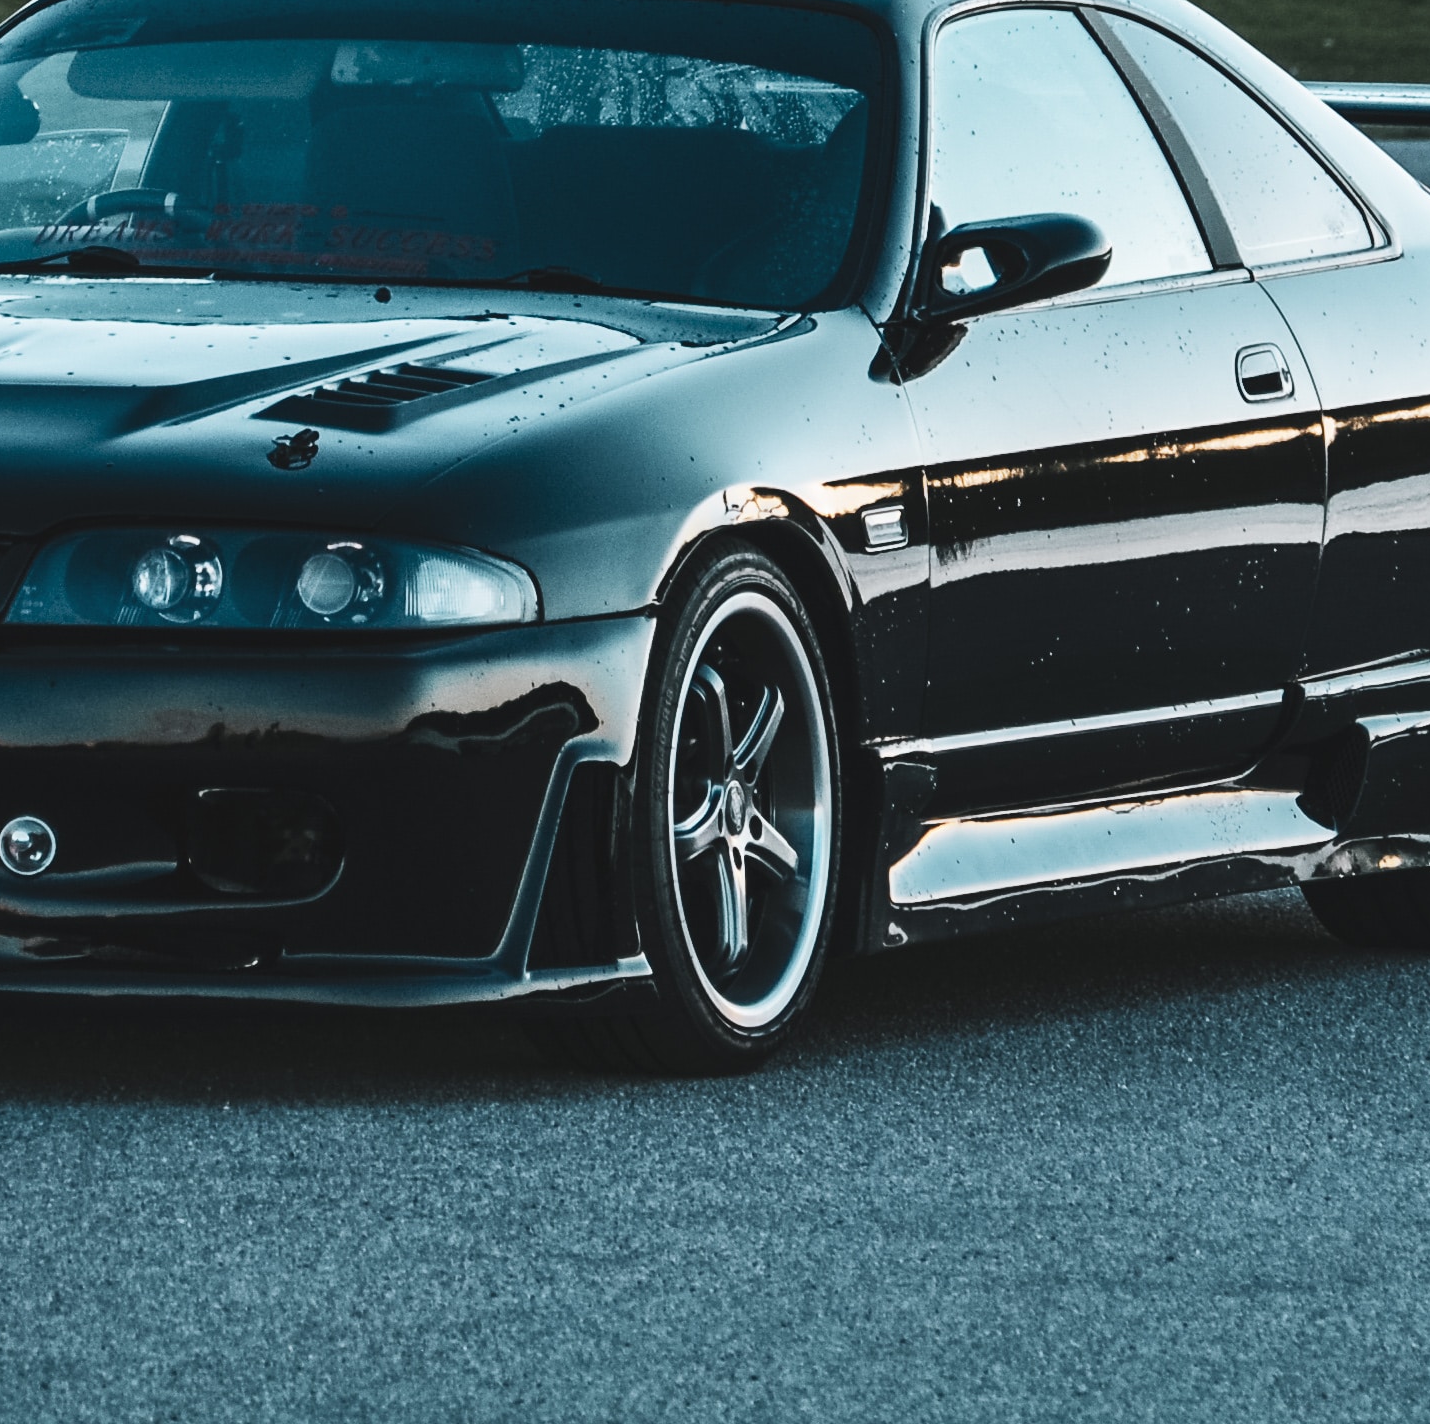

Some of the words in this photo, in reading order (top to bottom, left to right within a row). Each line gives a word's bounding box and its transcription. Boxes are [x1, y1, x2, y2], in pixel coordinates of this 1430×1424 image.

[32, 219, 178, 245] DREAMS
[202, 219, 303, 244] WORK
[324, 224, 502, 260] SUCCESS
